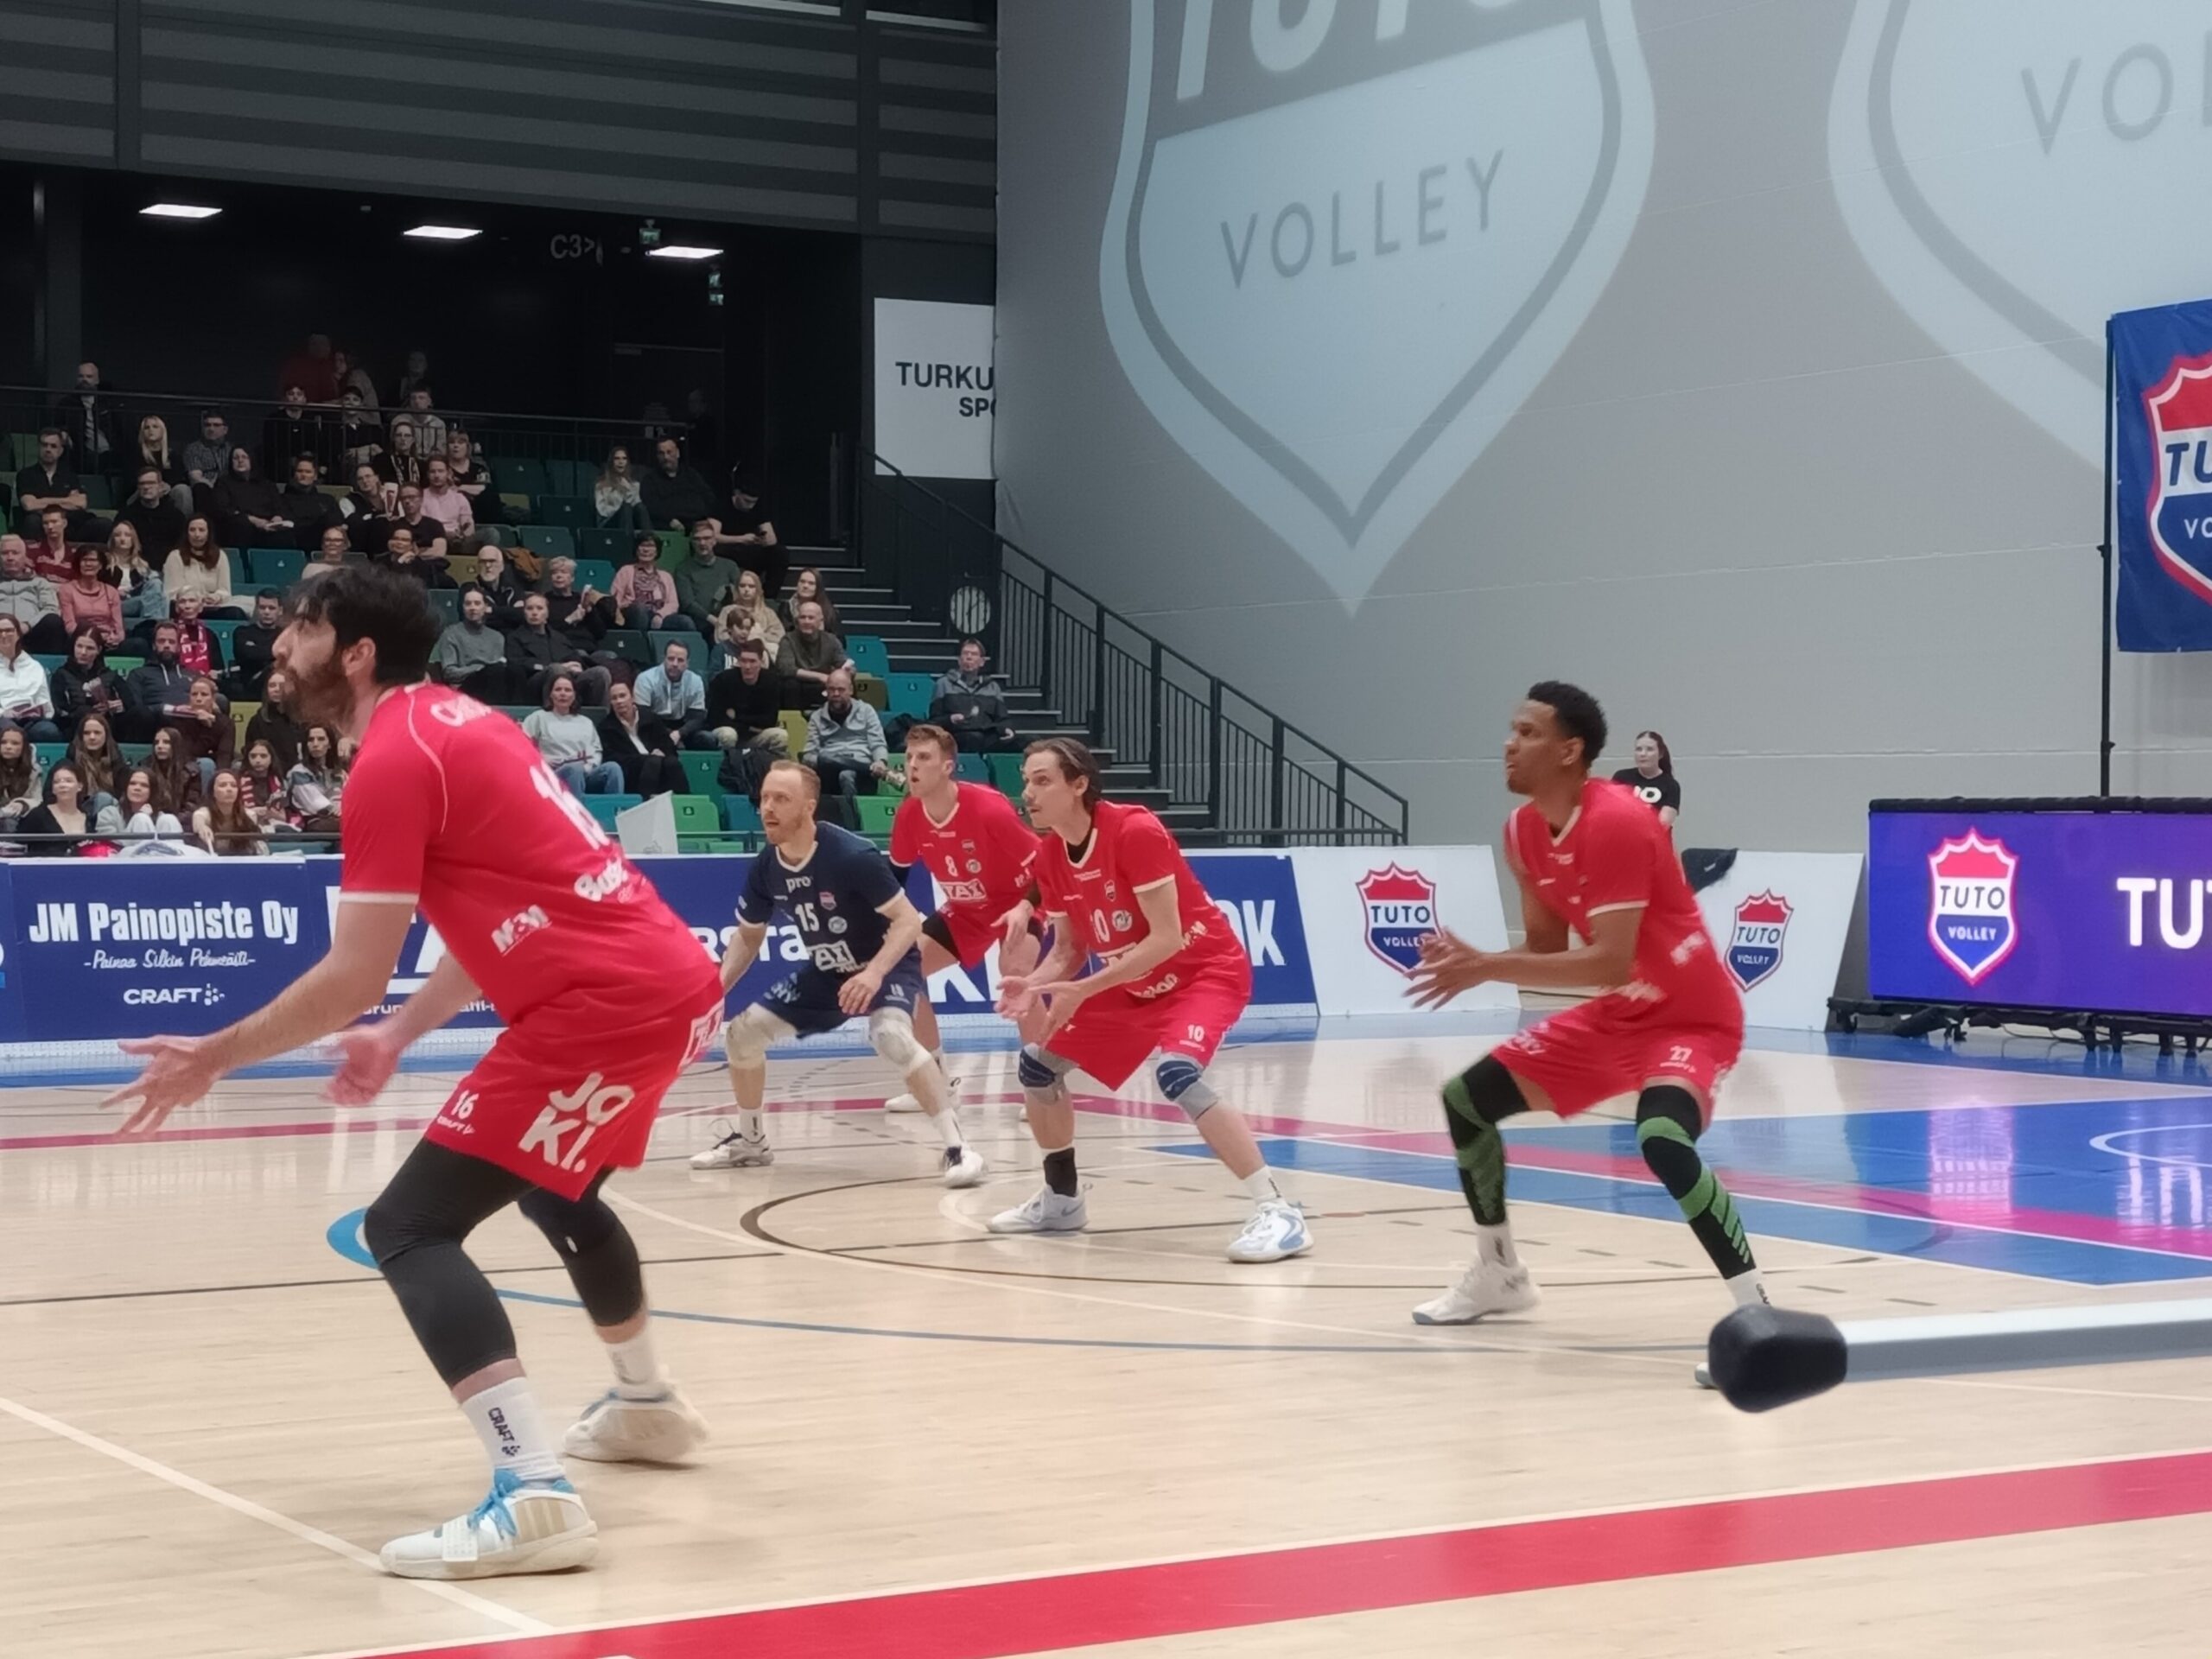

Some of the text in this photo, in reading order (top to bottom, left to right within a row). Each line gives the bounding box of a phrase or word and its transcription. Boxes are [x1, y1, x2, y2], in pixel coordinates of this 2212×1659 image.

[1220, 148, 1504, 289] VOLLEY
[895, 361, 994, 391] TURKU
[1940, 885, 2005, 910] TUTO
[29, 900, 299, 947] JM Painopiste Oy
[795, 902, 820, 931] 15
[1370, 906, 1431, 924] TUTO
[2116, 877, 2212, 950] TU
[1737, 926, 1781, 944] TUTO
[1948, 927, 1997, 942] VOLLEY
[124, 988, 202, 1005] CRAFT
[1187, 1024, 1205, 1042] 10
[450, 1089, 480, 1120] 16
[549, 1071, 635, 1127] JO
[487, 1407, 515, 1442] CRAFT
